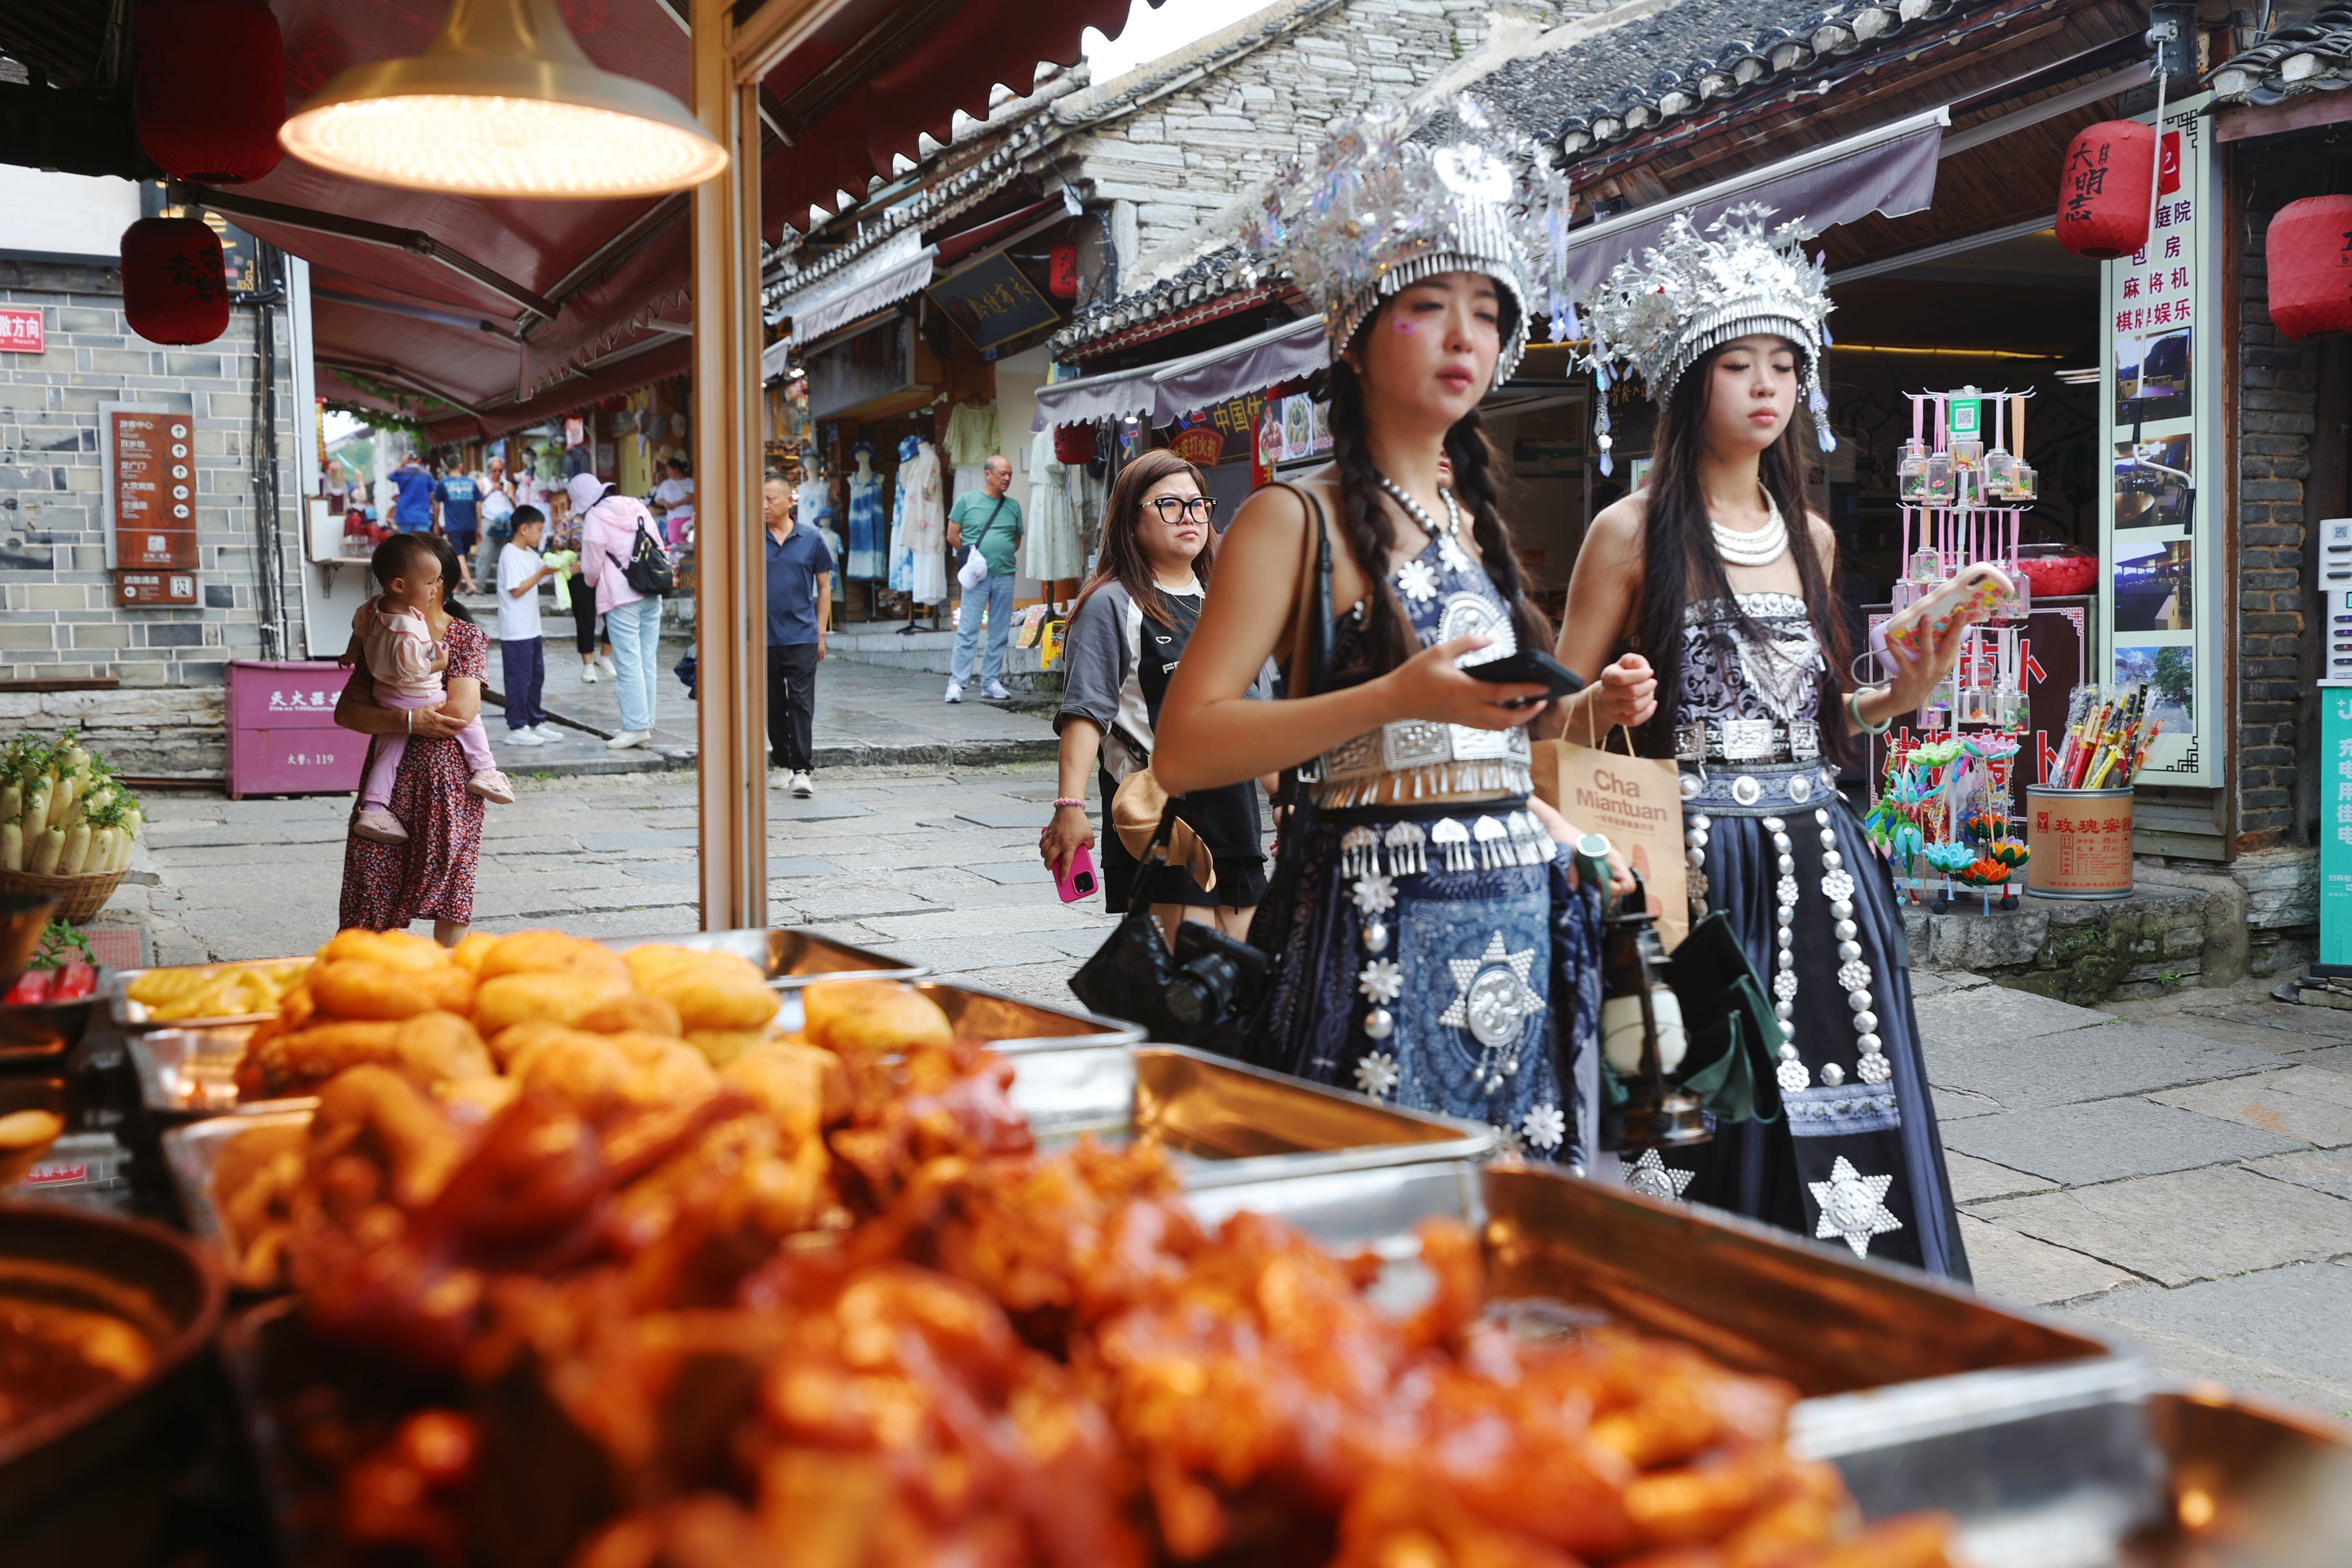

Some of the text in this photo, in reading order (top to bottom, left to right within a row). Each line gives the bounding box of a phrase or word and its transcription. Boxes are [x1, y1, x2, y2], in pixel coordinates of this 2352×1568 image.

[2066, 141, 2110, 222] 大明志
[2155, 199, 2191, 229] 庭院
[2122, 266, 2188, 299] 麻将机
[2116, 297, 2191, 333] 棋牌娱乐
[119, 420, 154, 430] 游客中心
[1173, 434, 1217, 465] 皮打火机
[121, 461, 147, 470] 定广门
[316, 754, 334, 765] 119
[1593, 769, 1640, 798] Cha
[1576, 787, 1668, 821] Miantuan
